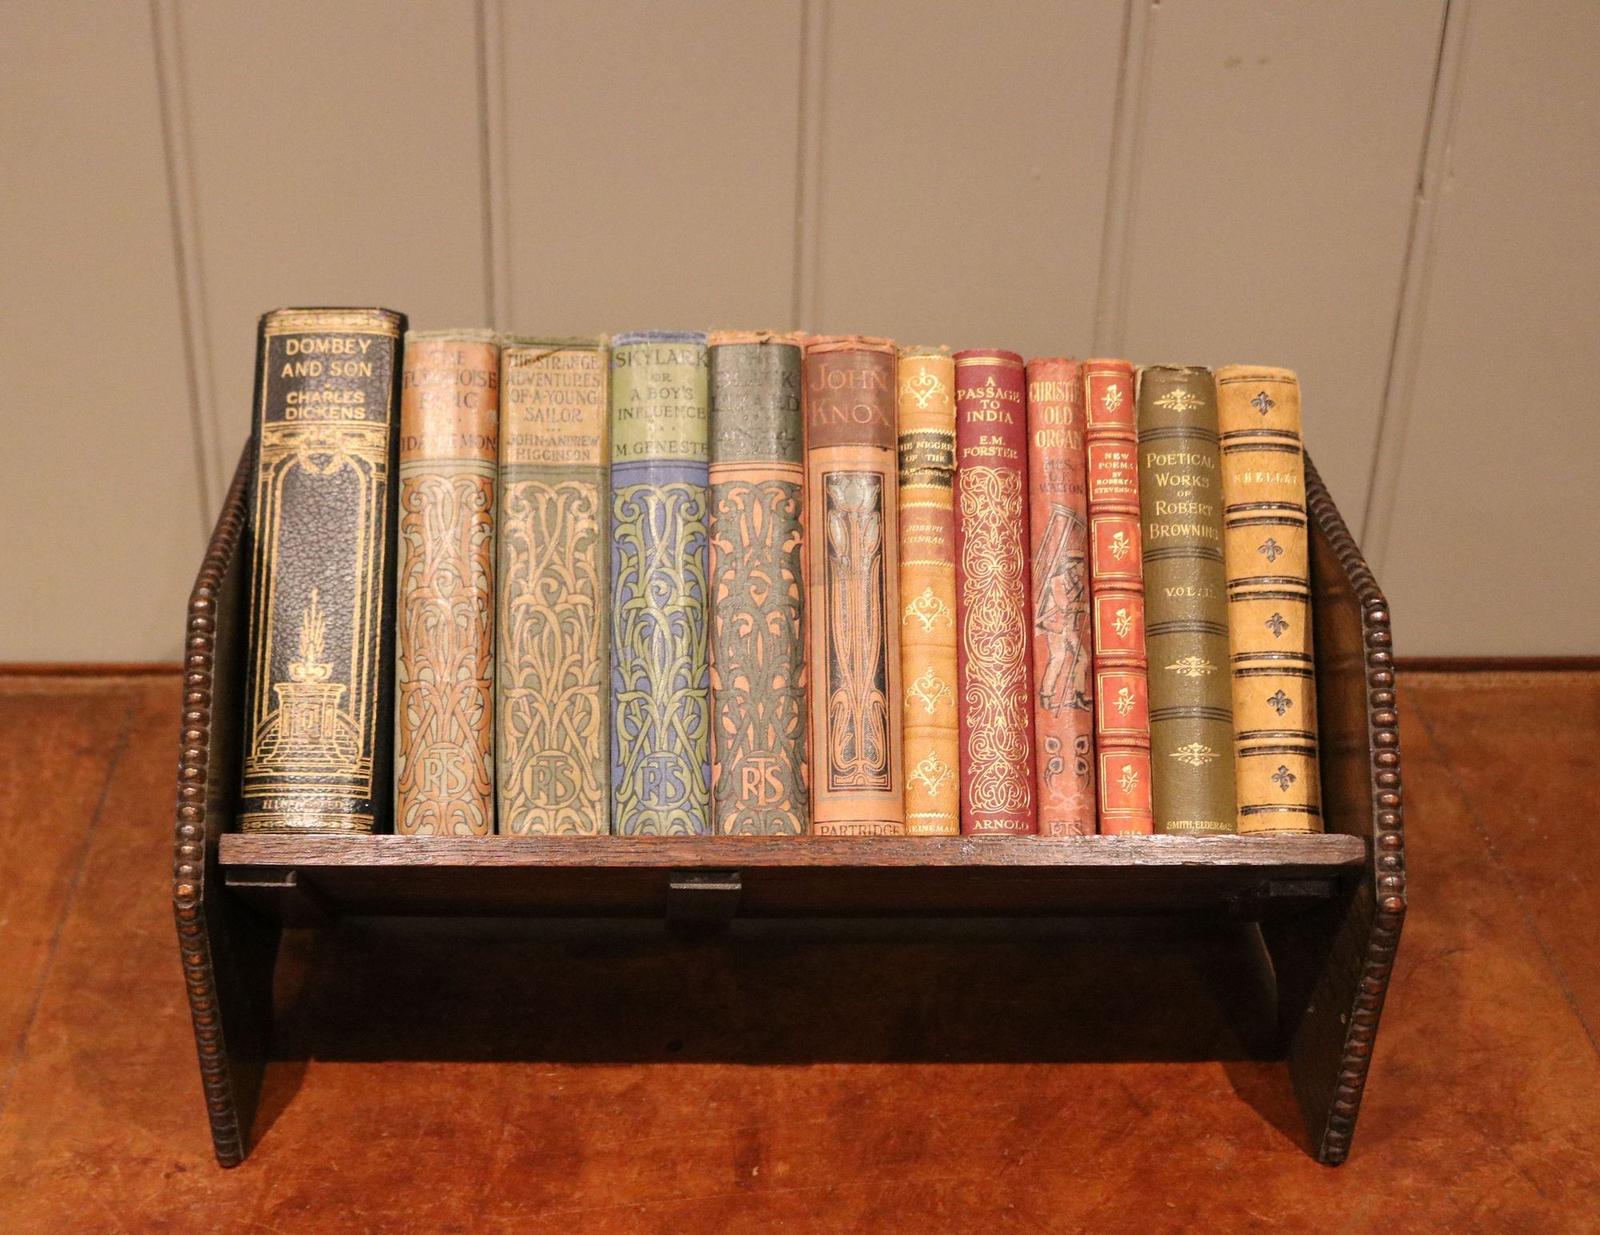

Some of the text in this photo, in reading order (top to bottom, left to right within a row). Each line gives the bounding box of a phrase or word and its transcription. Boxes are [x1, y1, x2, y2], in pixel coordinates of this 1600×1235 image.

[286, 337, 372, 355] DOMBEY
[615, 349, 712, 369] SKYLARK
[281, 361, 372, 378] AND SON
[507, 371, 601, 388] ADVENTURES
[810, 363, 889, 393] JOHN
[985, 376, 996, 388] A
[286, 389, 366, 405] CHARLES
[631, 385, 694, 402] A BOY'S
[957, 386, 1021, 404] PASSAGE
[812, 398, 890, 427] KNOX
[979, 399, 1001, 410] TO
[285, 406, 366, 420] DICKENS
[523, 407, 584, 423] SAILOR
[618, 405, 706, 421] INFLUENCE
[967, 410, 1014, 425] INDIA
[1044, 405, 1074, 426] OLD
[1035, 429, 1082, 451] ORGAN
[516, 447, 592, 462] HIGGINSON
[905, 453, 946, 463] OF THE
[962, 446, 1018, 460] FORSTER
[1104, 452, 1129, 460] NEW
[1146, 452, 1215, 469] POETICAL
[1098, 461, 1135, 470] POEMS
[1154, 471, 1210, 490] WORKS
[1177, 489, 1192, 497] OF
[1155, 500, 1214, 516] ROBERT
[973, 819, 1029, 831] ARNOLD
